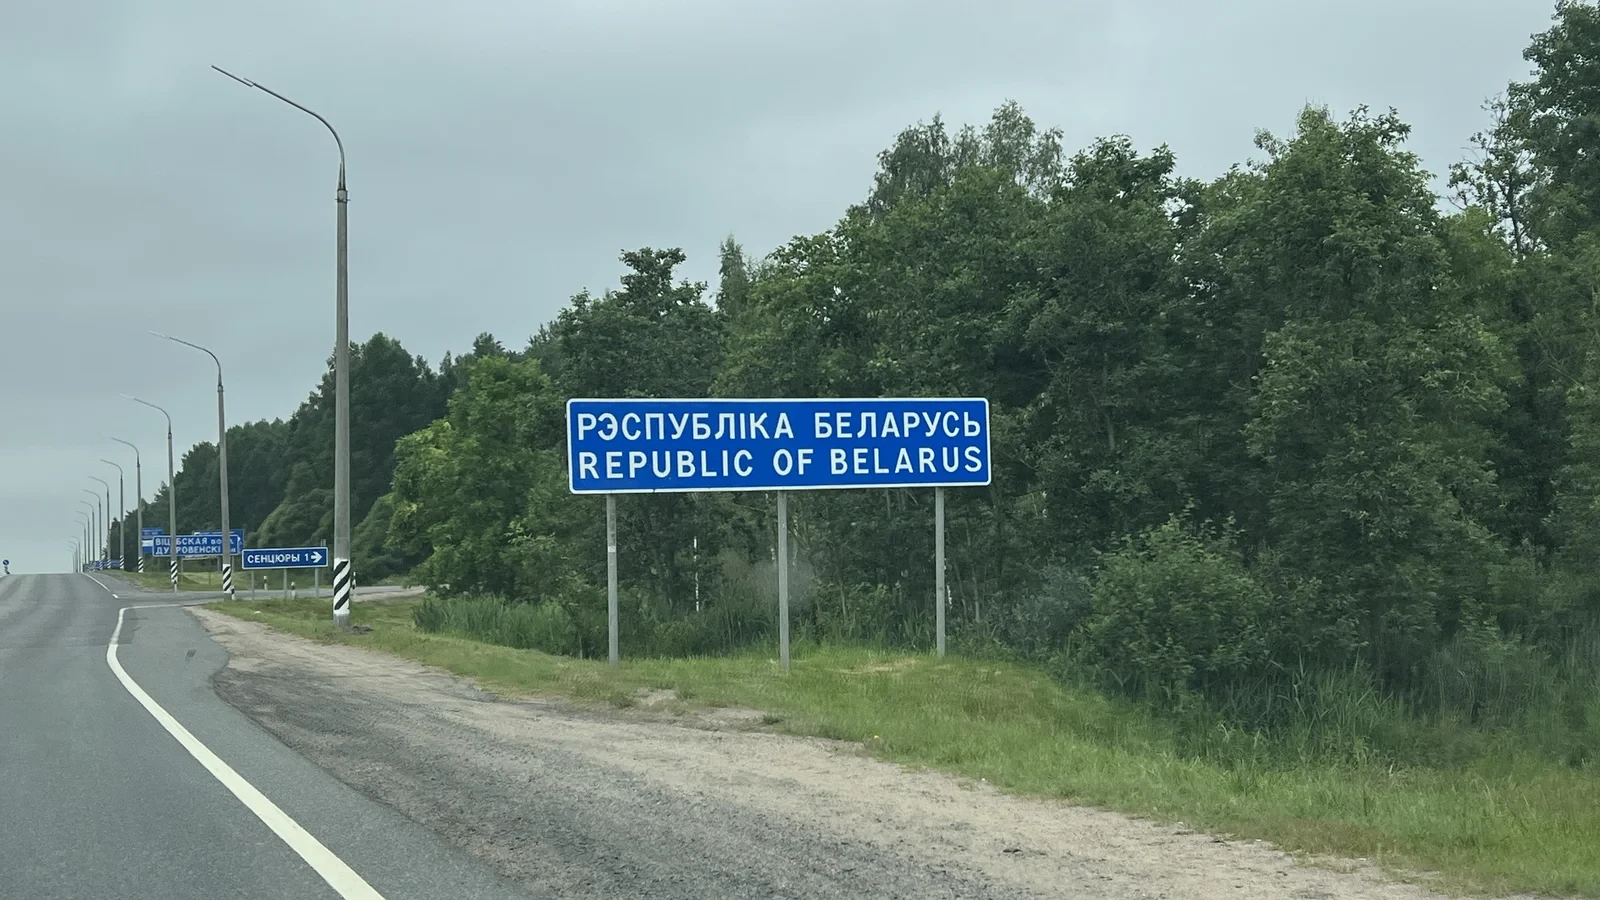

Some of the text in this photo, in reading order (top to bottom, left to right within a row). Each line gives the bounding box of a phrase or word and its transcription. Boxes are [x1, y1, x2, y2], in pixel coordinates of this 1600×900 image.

[577, 410, 982, 441] РЭСПУБЛІКА БЕЛАРУСЬ
[579, 446, 983, 480] REPUBLIC OF BELARUS
[155, 537, 207, 546] ВІЦБСКАЯ
[155, 546, 221, 555] ДУРОВЕНСКІ
[247, 553, 309, 564] СЕНЦЮРЫ 1
